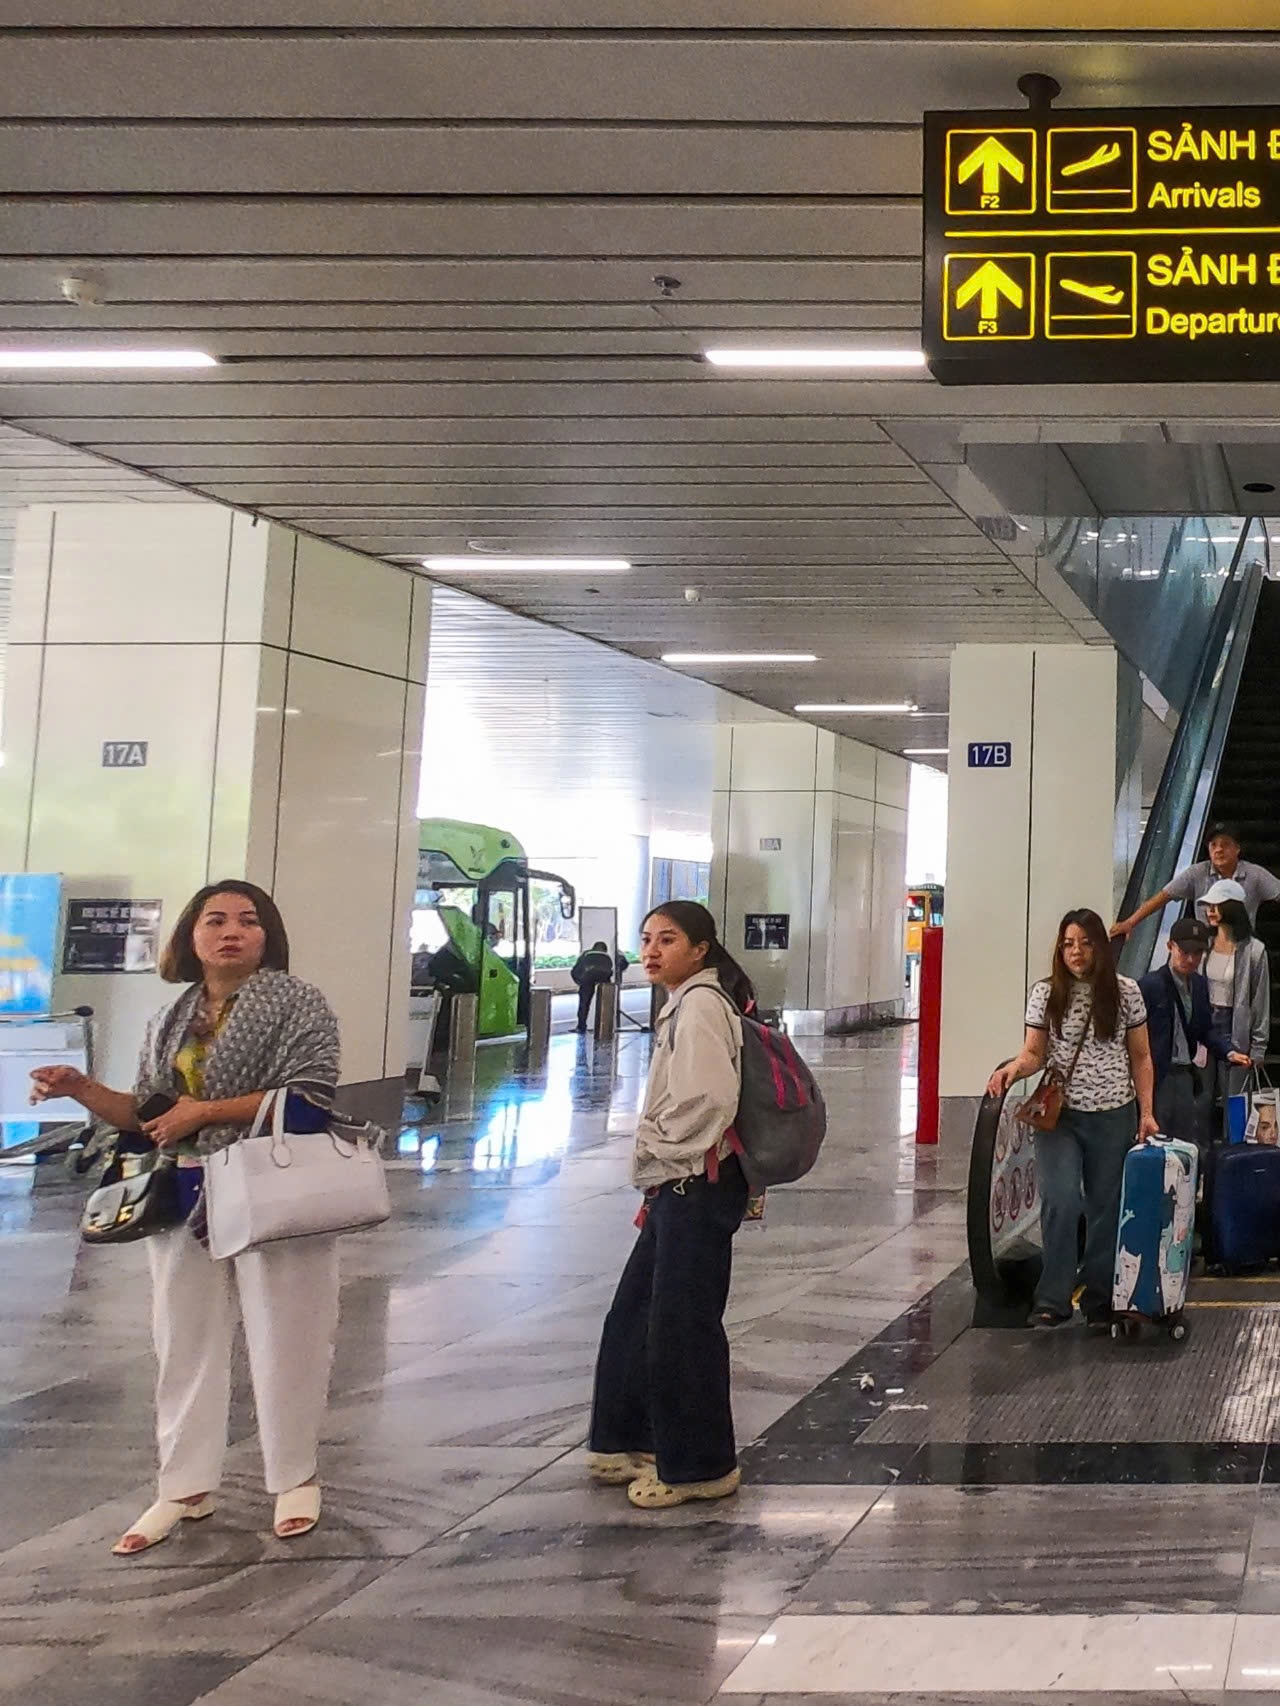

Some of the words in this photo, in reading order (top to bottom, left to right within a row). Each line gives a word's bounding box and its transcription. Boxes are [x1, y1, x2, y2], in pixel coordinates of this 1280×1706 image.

[1147, 123, 1257, 162] SẢNH
[980, 194, 1001, 209] F2
[1147, 181, 1262, 209] Arrivals
[1146, 246, 1257, 287] SẢNH
[978, 319, 998, 334] F3
[106, 743, 144, 765] 17A
[972, 745, 1007, 765] 17B
